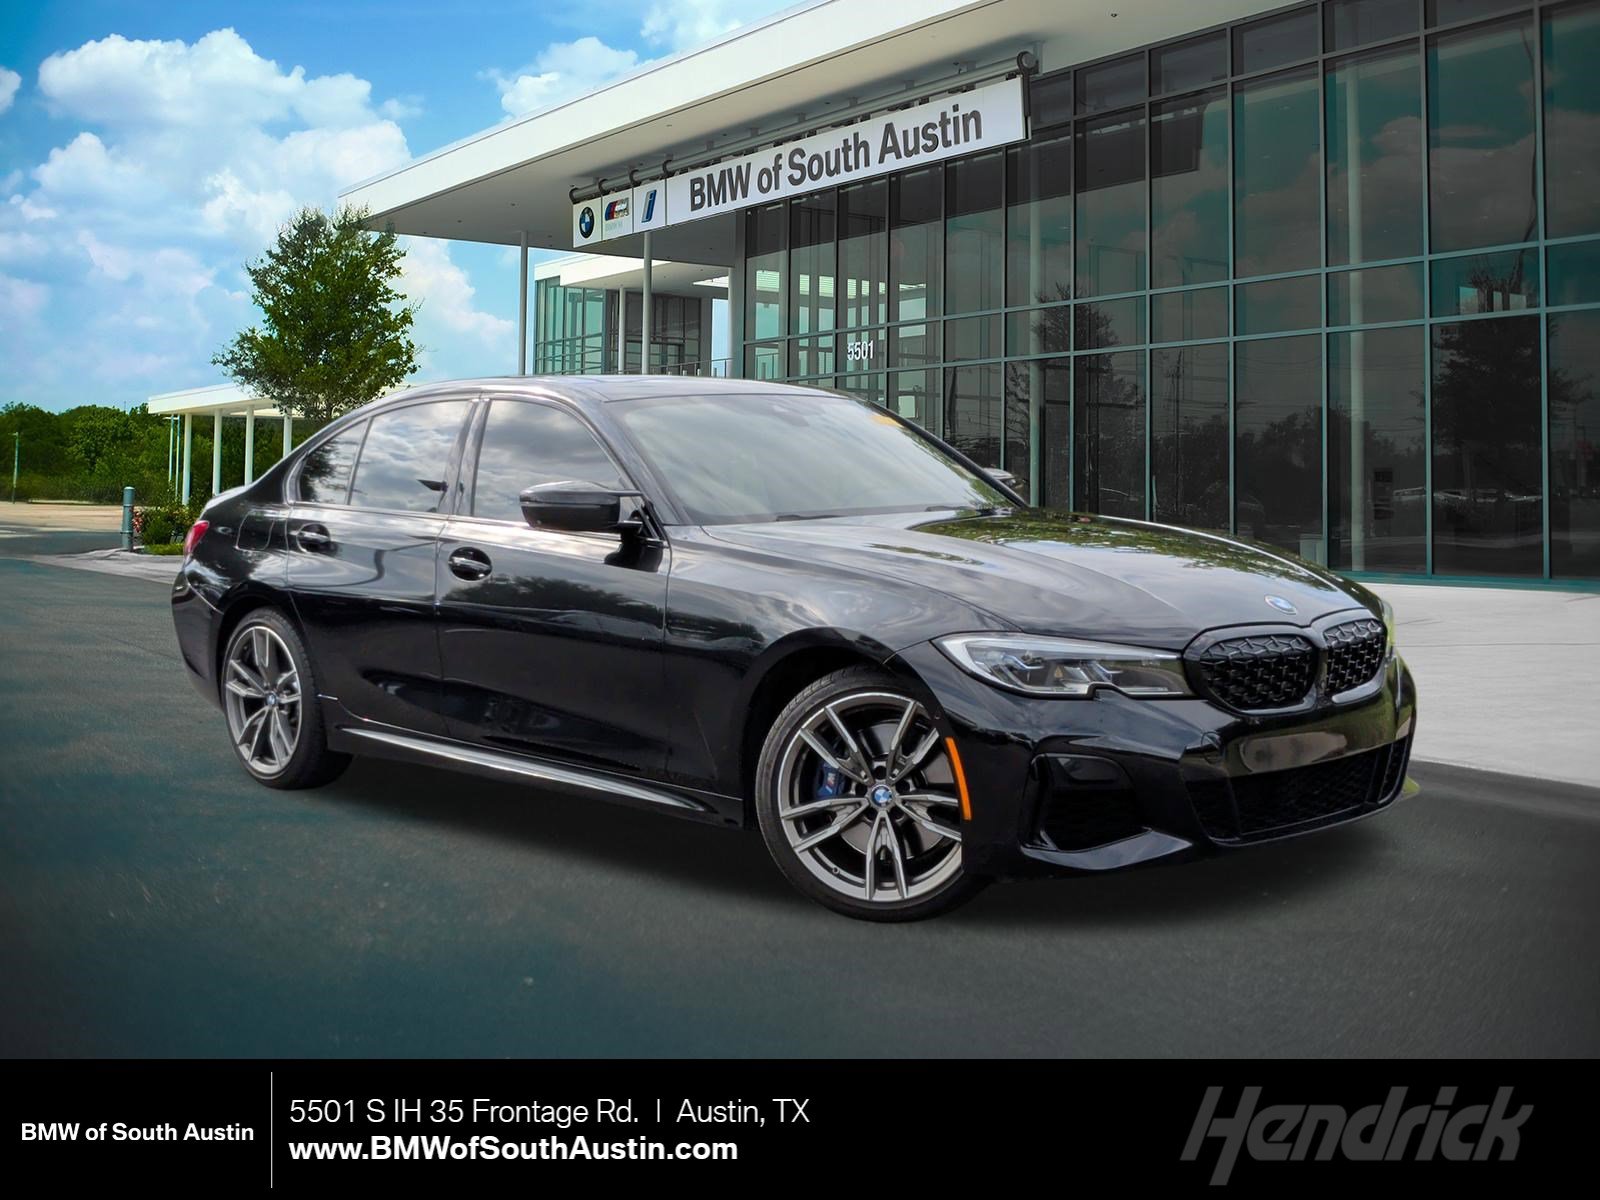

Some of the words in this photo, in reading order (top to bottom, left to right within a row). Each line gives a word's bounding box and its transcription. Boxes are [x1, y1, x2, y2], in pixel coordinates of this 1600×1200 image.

[690, 162, 751, 212] BMW
[757, 153, 783, 194] of
[788, 131, 871, 187] South
[878, 103, 982, 164] Austin
[847, 340, 873, 360] 5501
